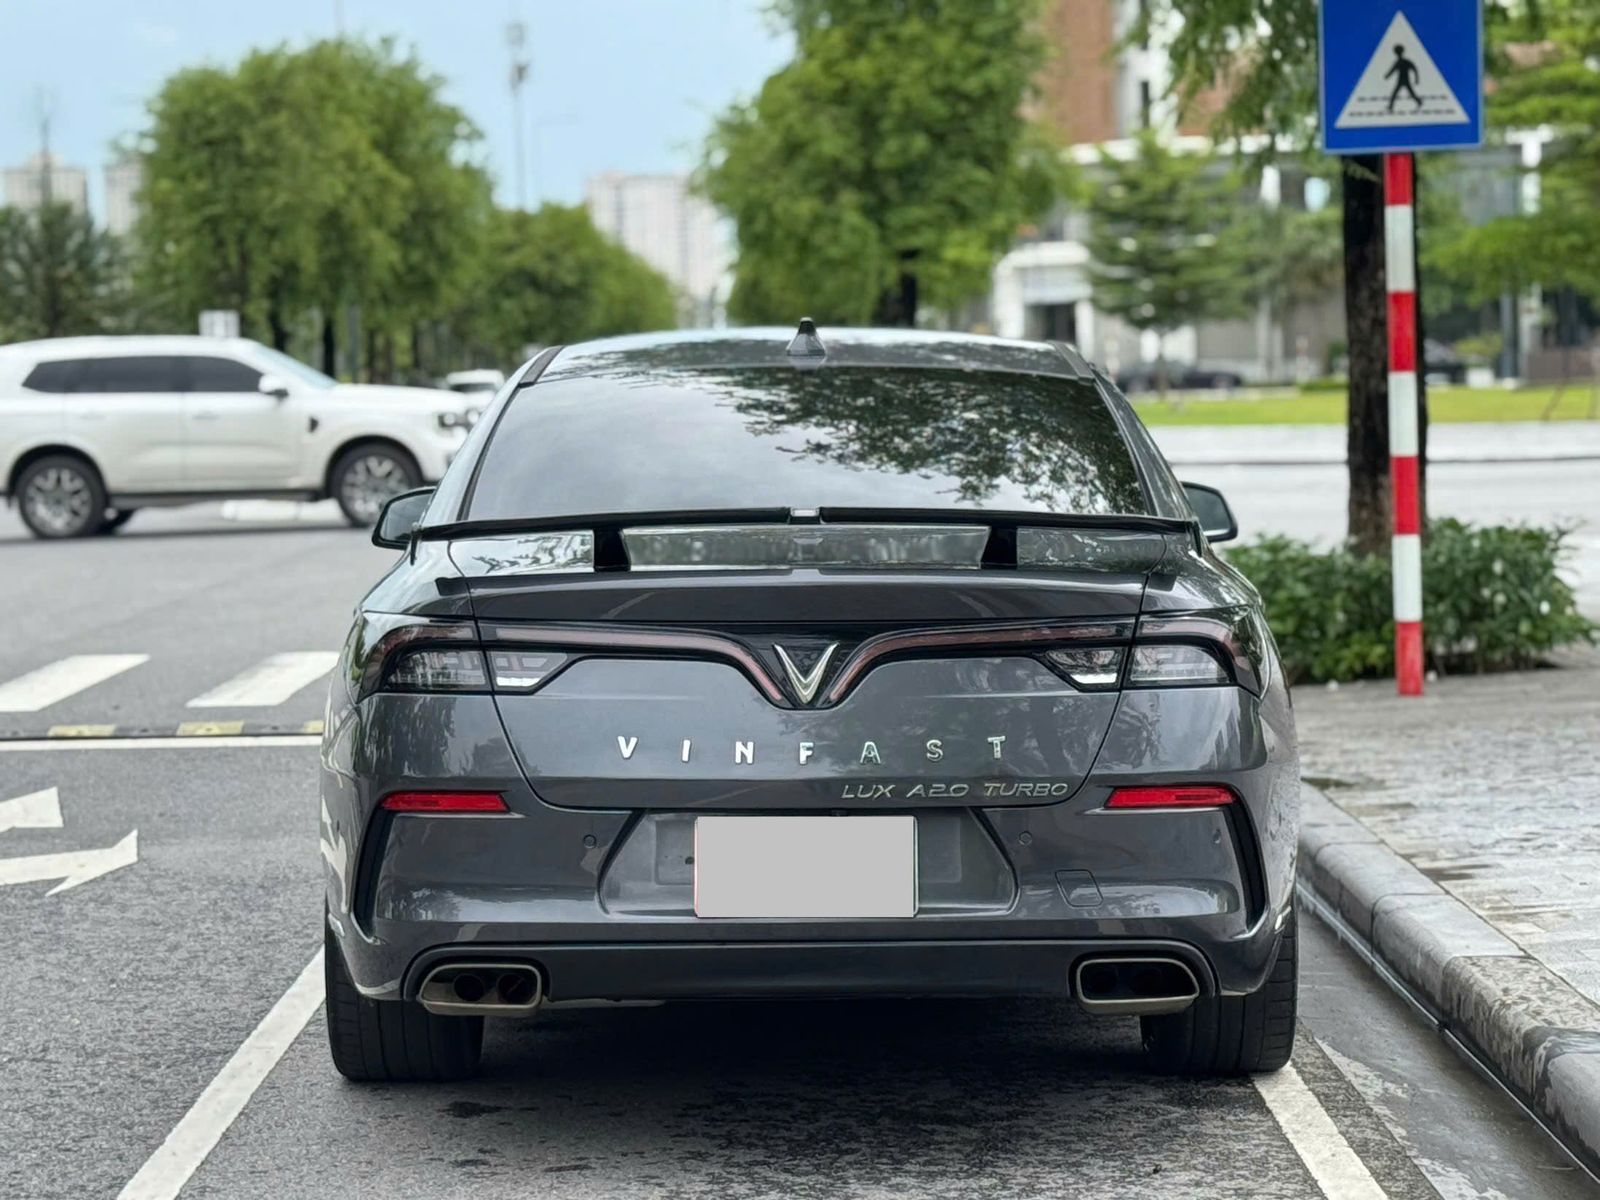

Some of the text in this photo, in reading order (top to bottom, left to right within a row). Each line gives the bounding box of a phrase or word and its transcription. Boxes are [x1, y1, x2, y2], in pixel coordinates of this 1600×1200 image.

[617, 735, 1006, 765] VINFAST
[841, 783, 896, 799] LUX
[983, 782, 1069, 797] TURBO
